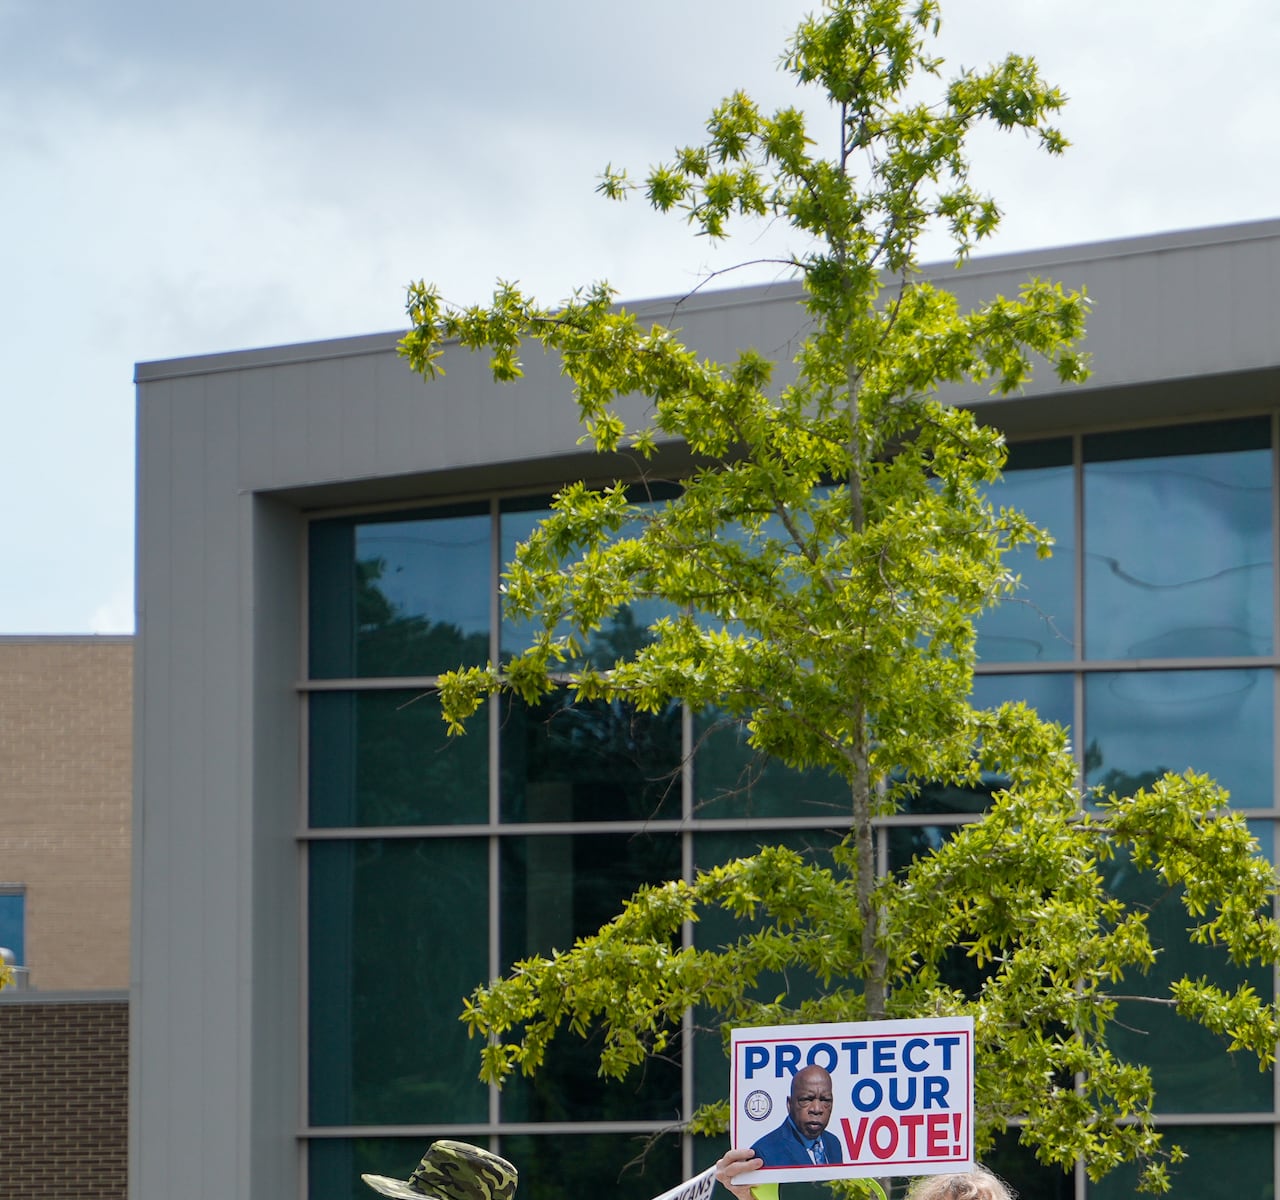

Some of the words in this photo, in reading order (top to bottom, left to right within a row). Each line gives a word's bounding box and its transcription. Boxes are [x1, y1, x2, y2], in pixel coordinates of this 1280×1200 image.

[744, 1037, 960, 1079] PROTECT
[851, 1075, 950, 1112] OUR
[840, 1113, 961, 1160] VOTE!
